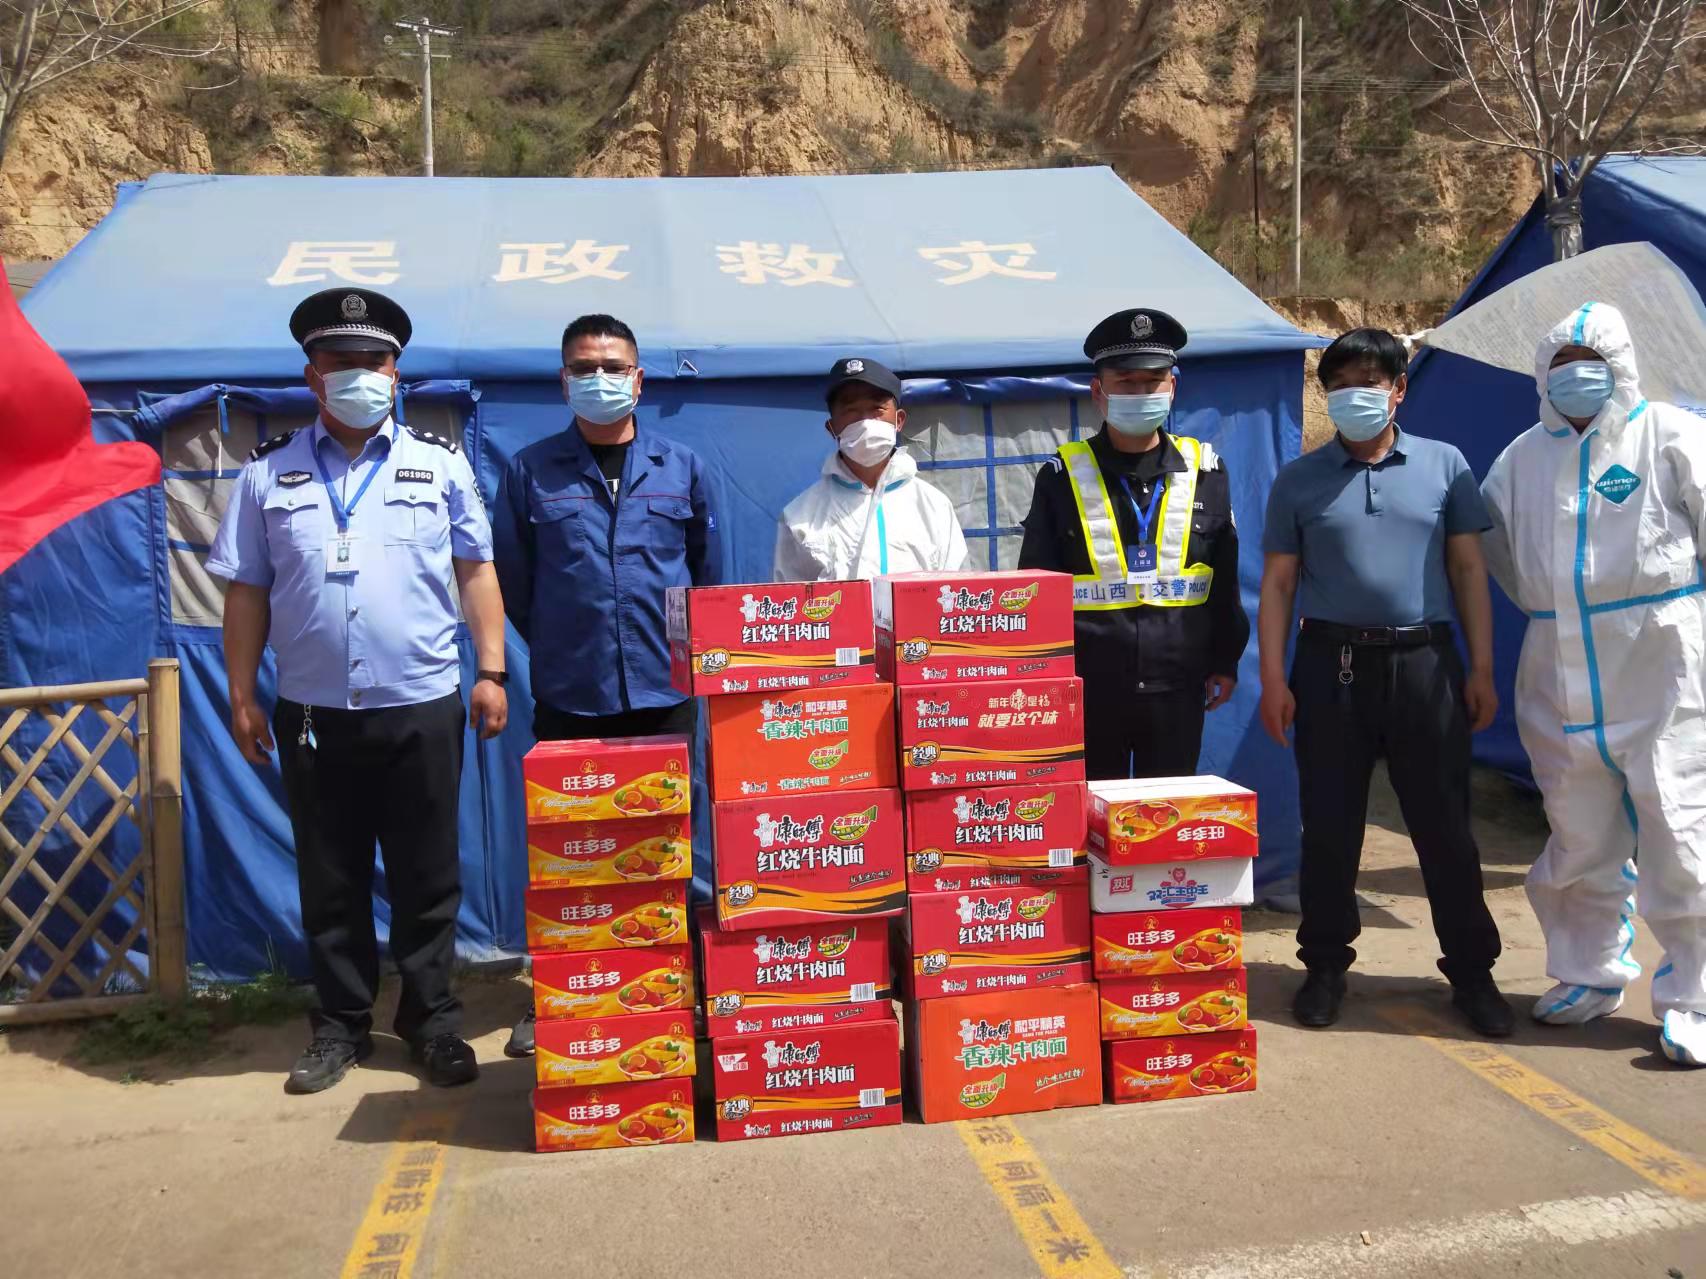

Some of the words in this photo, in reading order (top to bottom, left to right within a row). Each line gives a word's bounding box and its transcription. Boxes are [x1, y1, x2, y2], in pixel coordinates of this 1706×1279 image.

[266, 239, 1056, 286] 民政救灾
[1091, 583, 1127, 600] 山西
[1152, 579, 1186, 597] 交警
[742, 622, 830, 643] 红烧牛肉面
[939, 613, 1027, 634] 红烧牛肉面
[957, 664, 1008, 678] 红烧牛肉面
[757, 674, 809, 689] 红烧牛肉面
[757, 717, 848, 741] 香辣牛肉面
[917, 715, 969, 729] 红烧牛肉面
[978, 711, 1059, 729] 就要这个味
[562, 773, 616, 791] 旺多多
[966, 769, 1016, 782] 红烧牛肉面
[955, 822, 1043, 845] 红烧牛肉面
[1177, 825, 1225, 842] 旺多多
[563, 838, 617, 855] 旺多多
[757, 842, 865, 873] 红烧牛肉面
[561, 903, 613, 921] 旺多多
[958, 920, 1045, 945] 红烧牛肉面
[1127, 929, 1176, 946] 旺多多
[568, 971, 621, 990] 旺多多
[756, 959, 845, 985] 红烧牛肉面
[976, 974, 1027, 989] 红烧牛肉面
[1132, 991, 1180, 1008] 旺多多
[771, 1013, 824, 1028] 红烧牛肉面
[569, 1037, 621, 1055] 旺多多
[954, 1037, 1067, 1070] 香辣牛肉面
[1146, 1054, 1193, 1071] 旺多多
[765, 1064, 855, 1090] 红烧牛肉面
[569, 1103, 620, 1120] 旺多多
[780, 1118, 833, 1133] 红烧牛肉面
